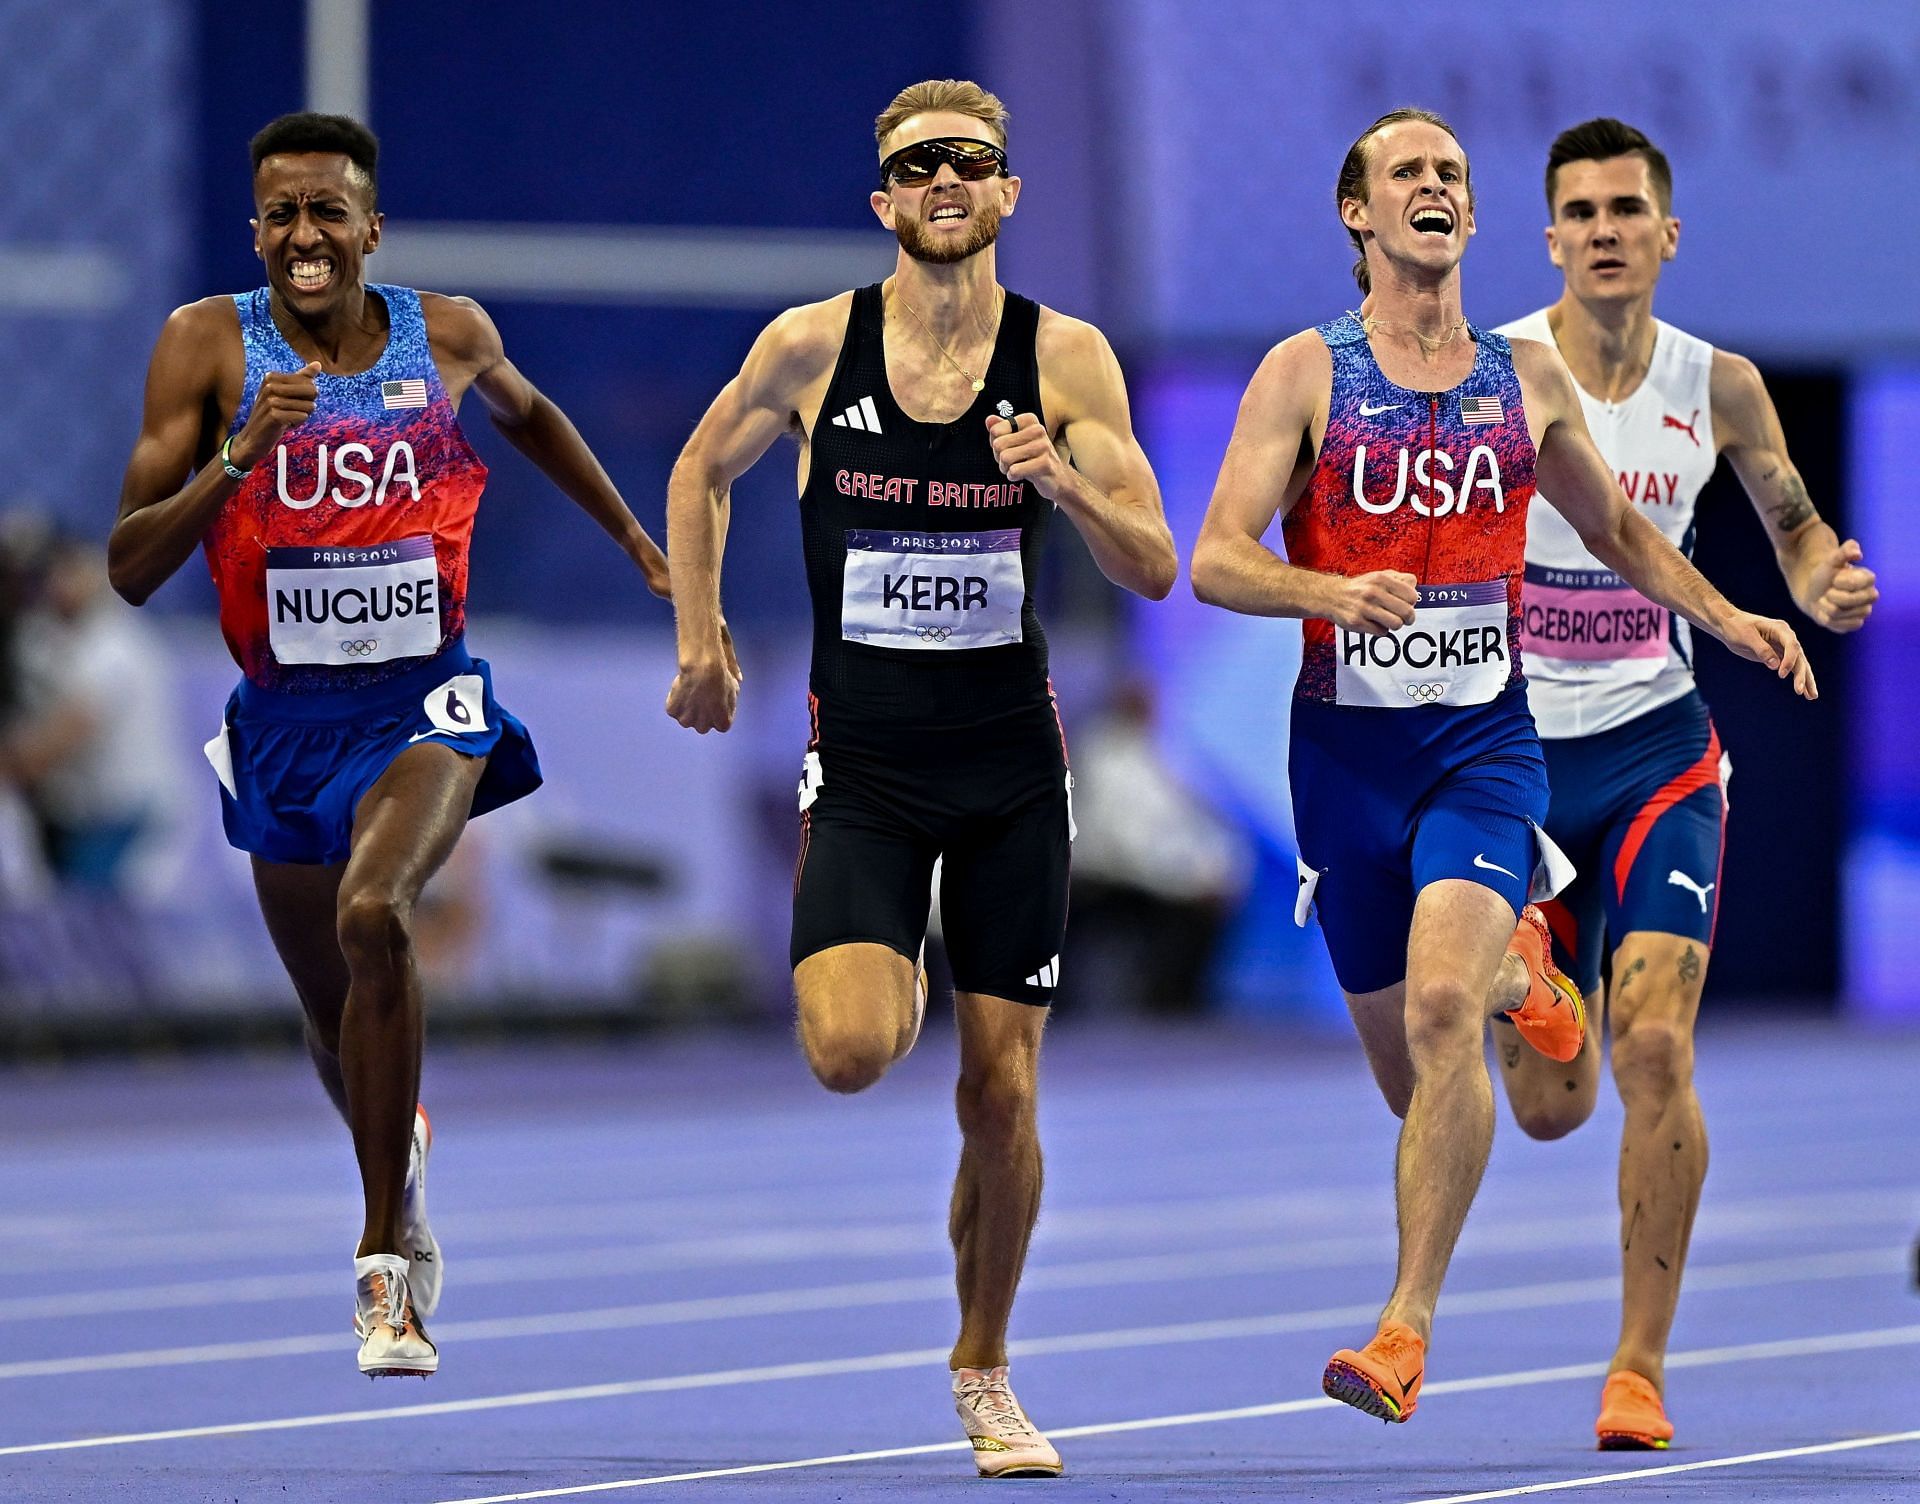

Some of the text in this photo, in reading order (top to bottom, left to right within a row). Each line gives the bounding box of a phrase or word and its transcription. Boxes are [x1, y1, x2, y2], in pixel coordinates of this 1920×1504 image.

[277, 440, 422, 510] USA
[835, 469, 1024, 508] GREAT BRITAIN
[1353, 445, 1505, 517] USA
[1619, 471, 1679, 505] WAY
[313, 548, 398, 563] PARIS 2024
[892, 537, 980, 549] PARIS 2024
[883, 574, 989, 611] KERR
[1428, 590, 1468, 602] 2024
[1546, 571, 1620, 586] PARIS 202
[276, 579, 434, 624] NUGUSE
[1521, 602, 1661, 643] GEBRIGTSEN
[1343, 626, 1505, 669] HOCKER
[446, 690, 471, 725] 6
